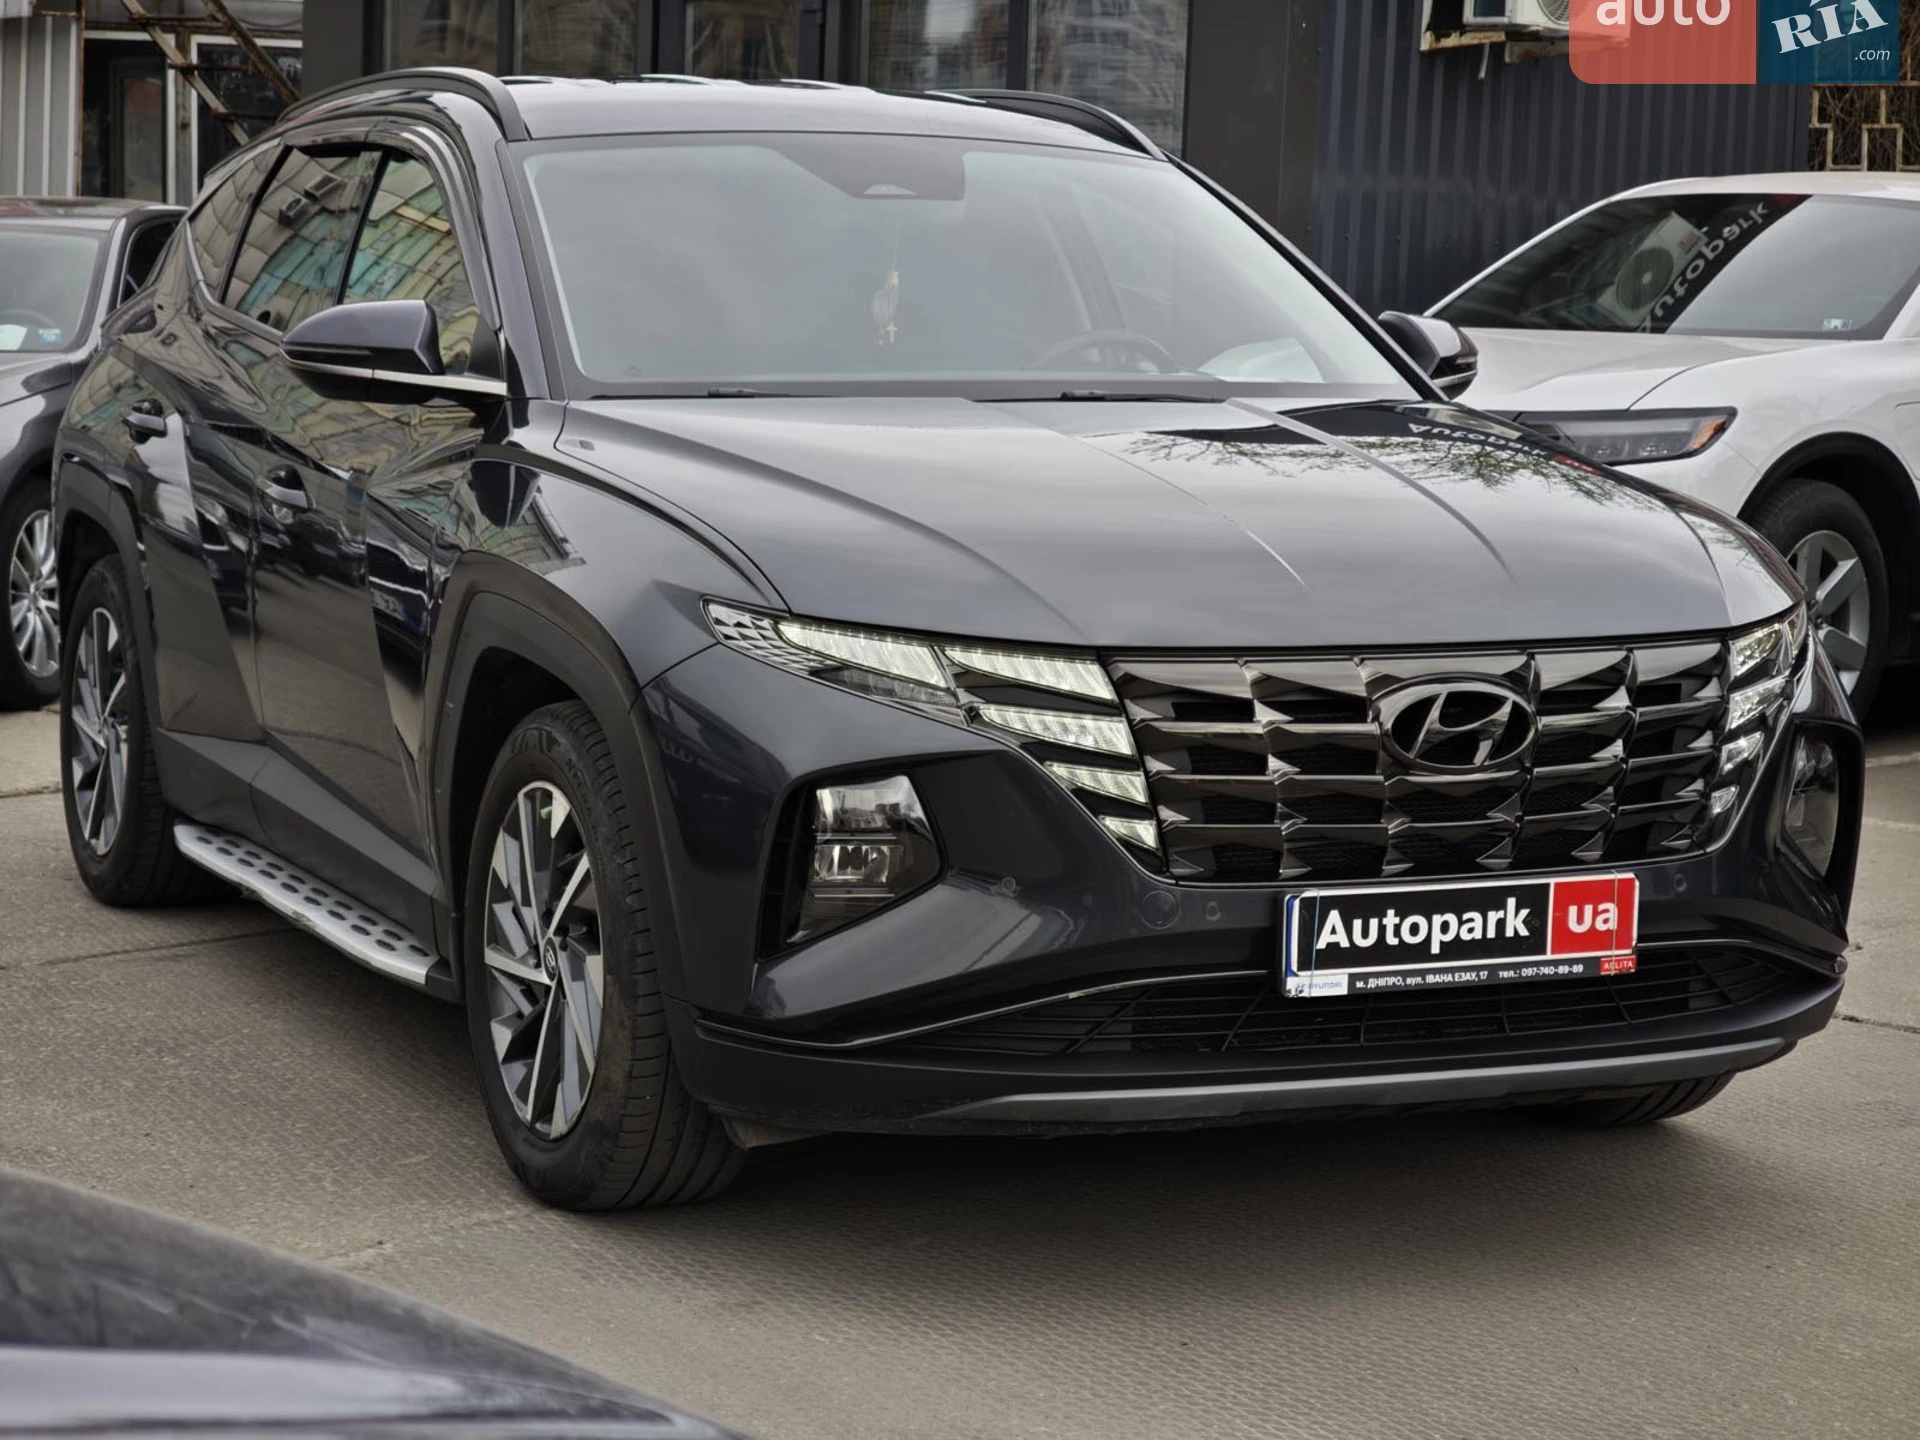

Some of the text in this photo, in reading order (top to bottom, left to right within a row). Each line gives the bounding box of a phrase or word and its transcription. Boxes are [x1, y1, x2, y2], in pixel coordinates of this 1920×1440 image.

[1315, 896, 1618, 954] Autopark ua
[1355, 980, 1366, 989] м.
[1367, 975, 1405, 990] ДНІПРО,
[1406, 976, 1424, 986] вул.
[1426, 972, 1453, 984] ІВАНА
[1455, 971, 1478, 983] ЕЗАУ,
[1479, 970, 1489, 981] 17
[1521, 964, 1584, 977] 097-740-89-89
